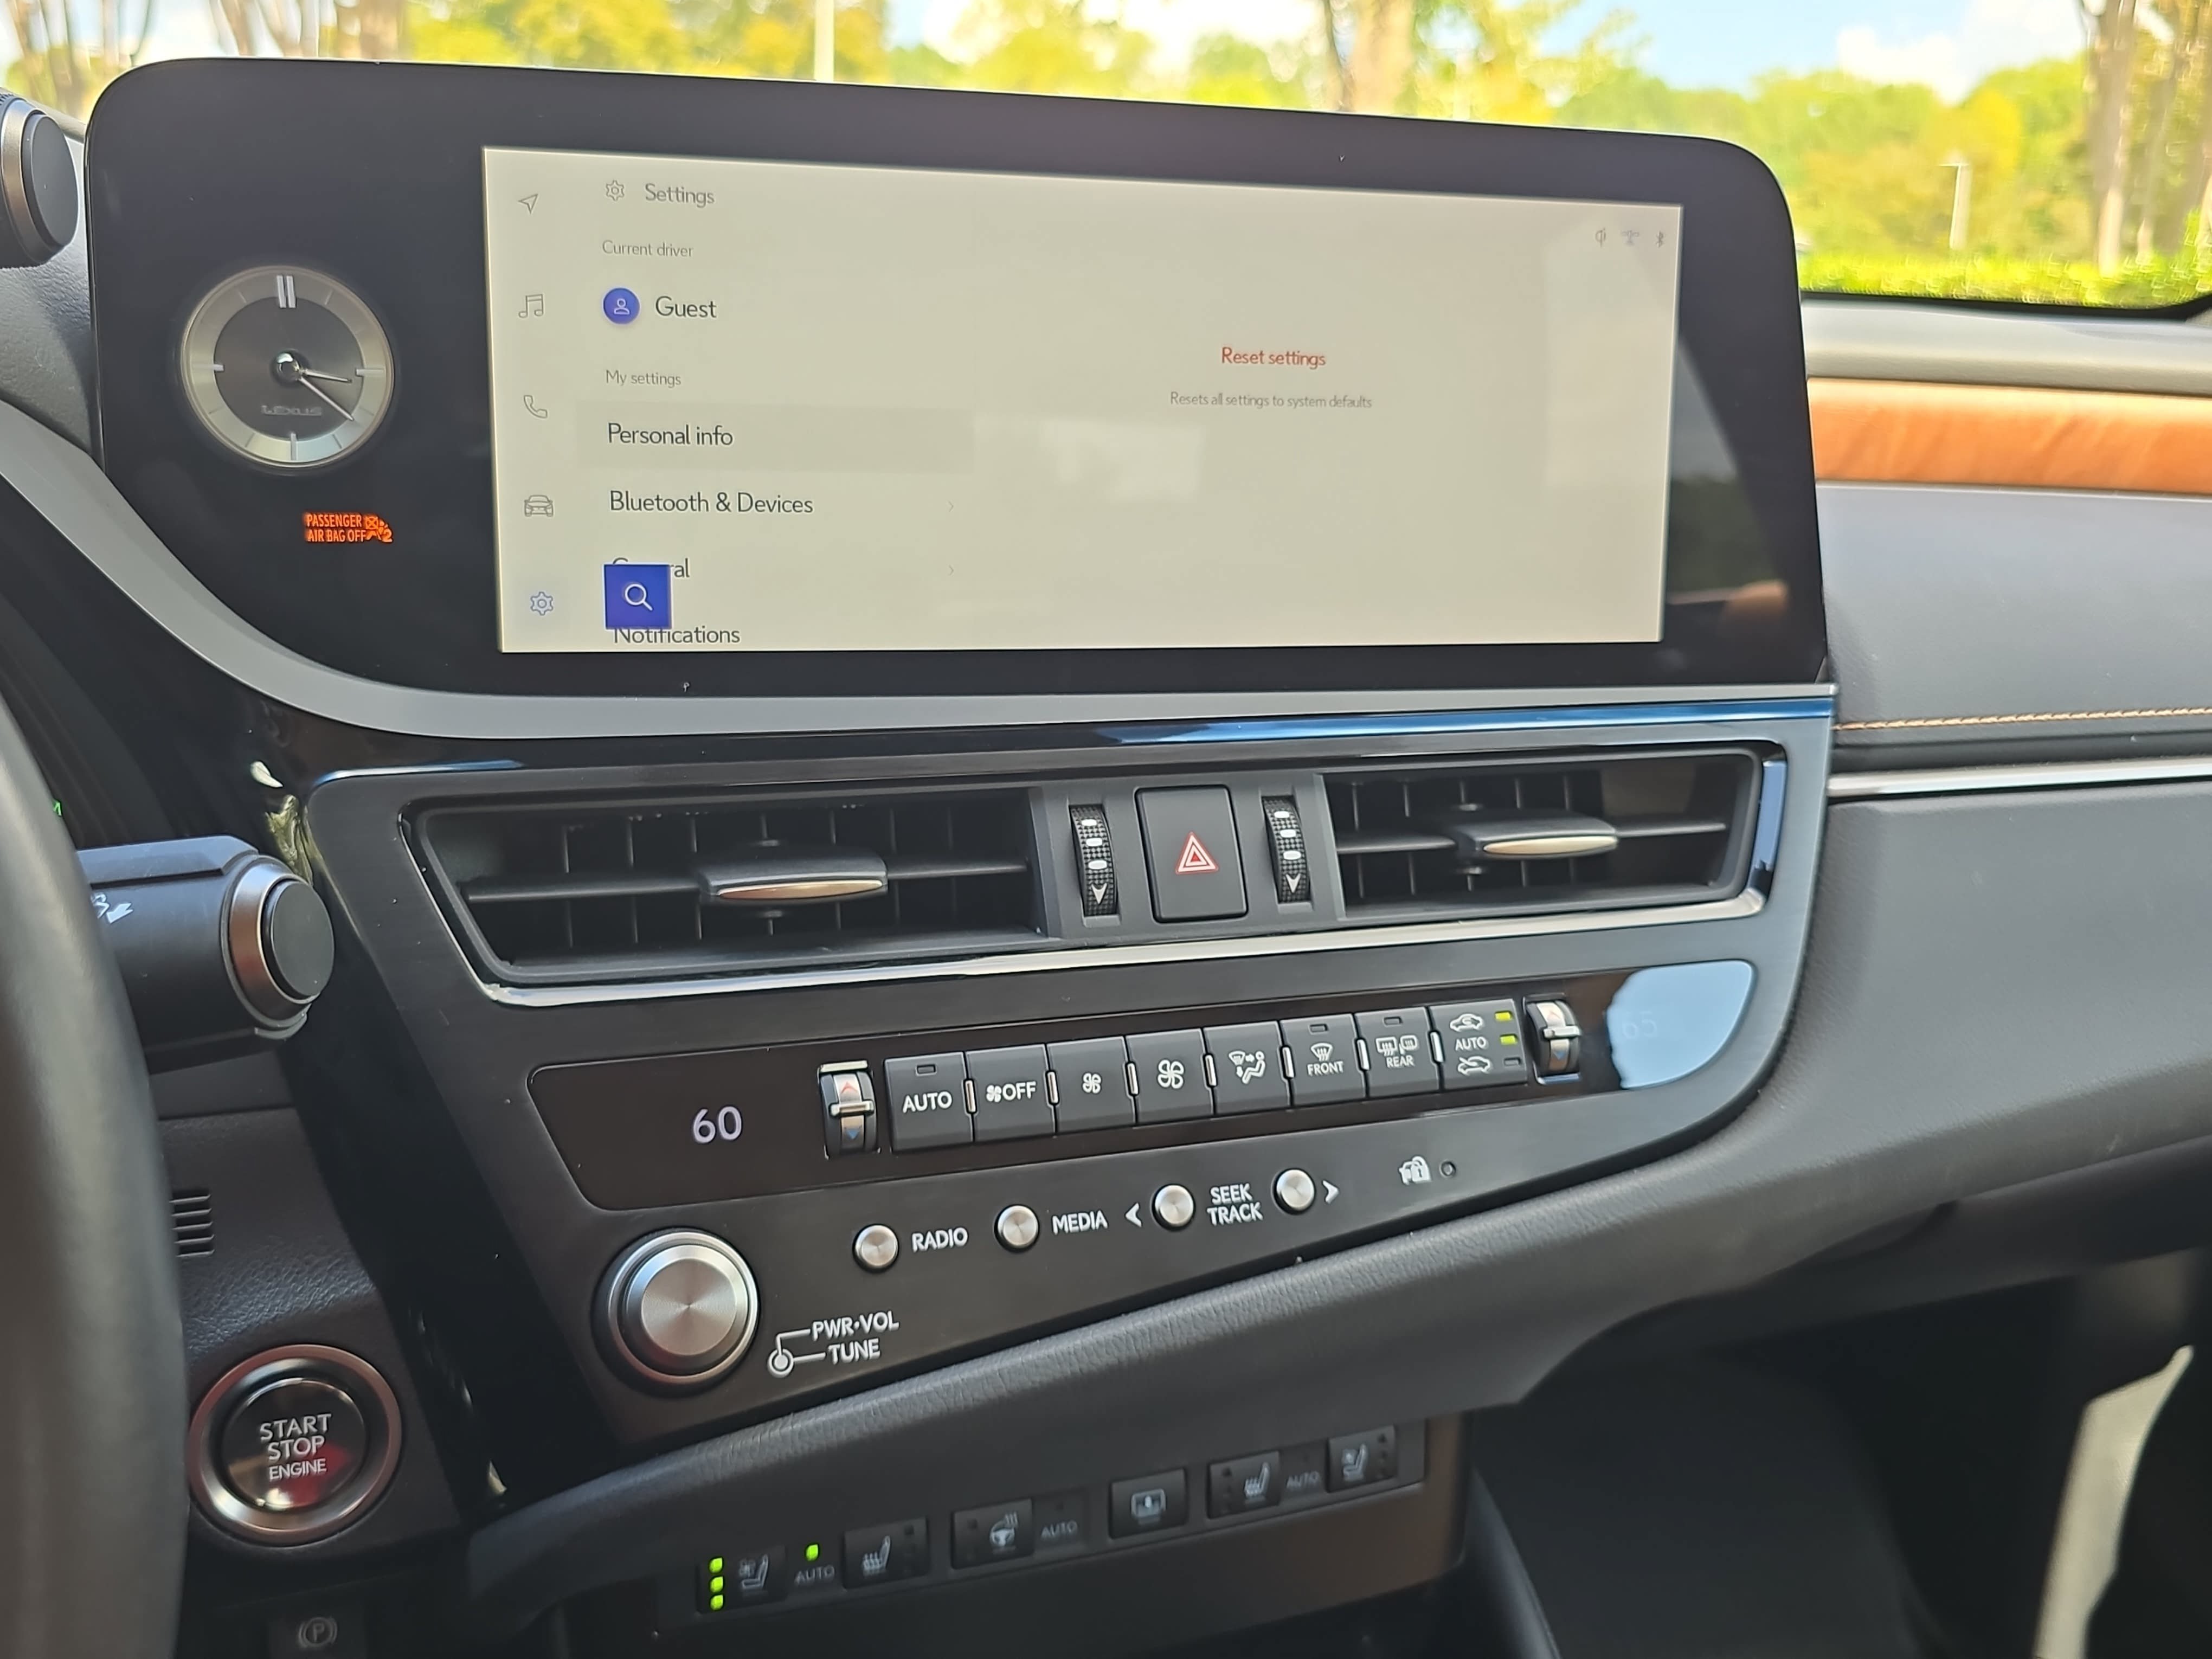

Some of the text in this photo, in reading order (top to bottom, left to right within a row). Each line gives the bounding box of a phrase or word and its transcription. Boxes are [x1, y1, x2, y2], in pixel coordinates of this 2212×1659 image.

[645, 183, 715, 208] Settings
[602, 240, 693, 258] Current driver
[655, 295, 717, 318] Guest
[1221, 347, 1326, 370] Reset settings
[606, 369, 681, 388] My settings
[1171, 391, 1372, 409] Resets all settings to system defaults
[608, 422, 733, 446] Personal info
[609, 491, 814, 513] Bluetooth & Devices
[305, 515, 362, 527] PASSENGER
[307, 530, 366, 542] AIR BAG OFF
[614, 626, 741, 644] Notifications
[1455, 1035, 1488, 1052] AUTO
[1307, 1059, 1344, 1076] FRONT
[1386, 1053, 1414, 1069] REAR
[1002, 1081, 1037, 1101] OFF
[902, 1091, 953, 1114] AUTO
[692, 1106, 743, 1144] 60
[1210, 1183, 1252, 1205] SEEK
[1052, 1210, 1108, 1234] MEDIA
[1207, 1201, 1263, 1225] TRACK
[911, 1228, 968, 1251] RADIO
[828, 1339, 880, 1365] TUNE
[260, 1413, 331, 1442] START
[268, 1435, 325, 1461] STOP
[269, 1459, 326, 1480] ENGINE
[1287, 1471, 1322, 1490] AUTO
[1041, 1521, 1077, 1539] AUTO
[795, 1565, 835, 1585] AUTO
